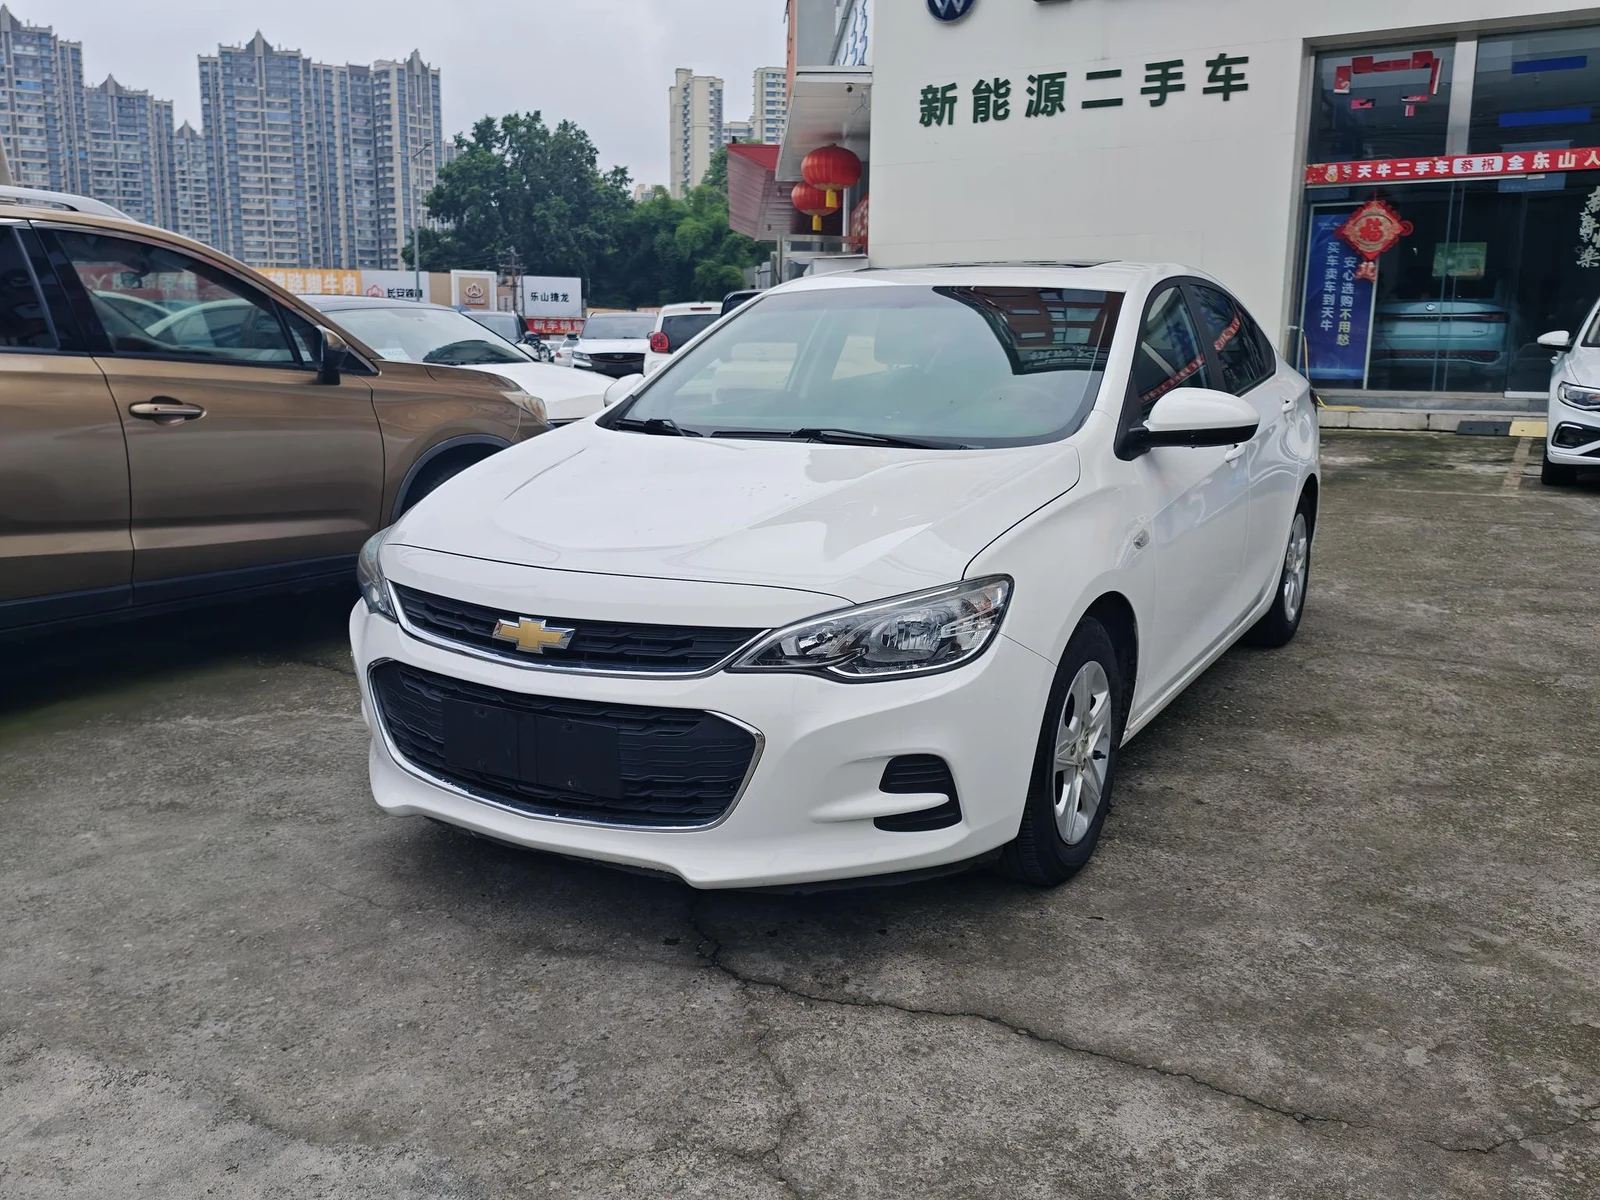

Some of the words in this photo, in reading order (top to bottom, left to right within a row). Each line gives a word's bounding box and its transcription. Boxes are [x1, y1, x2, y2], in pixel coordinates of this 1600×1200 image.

[919, 53, 1249, 127] 新能源二手车
